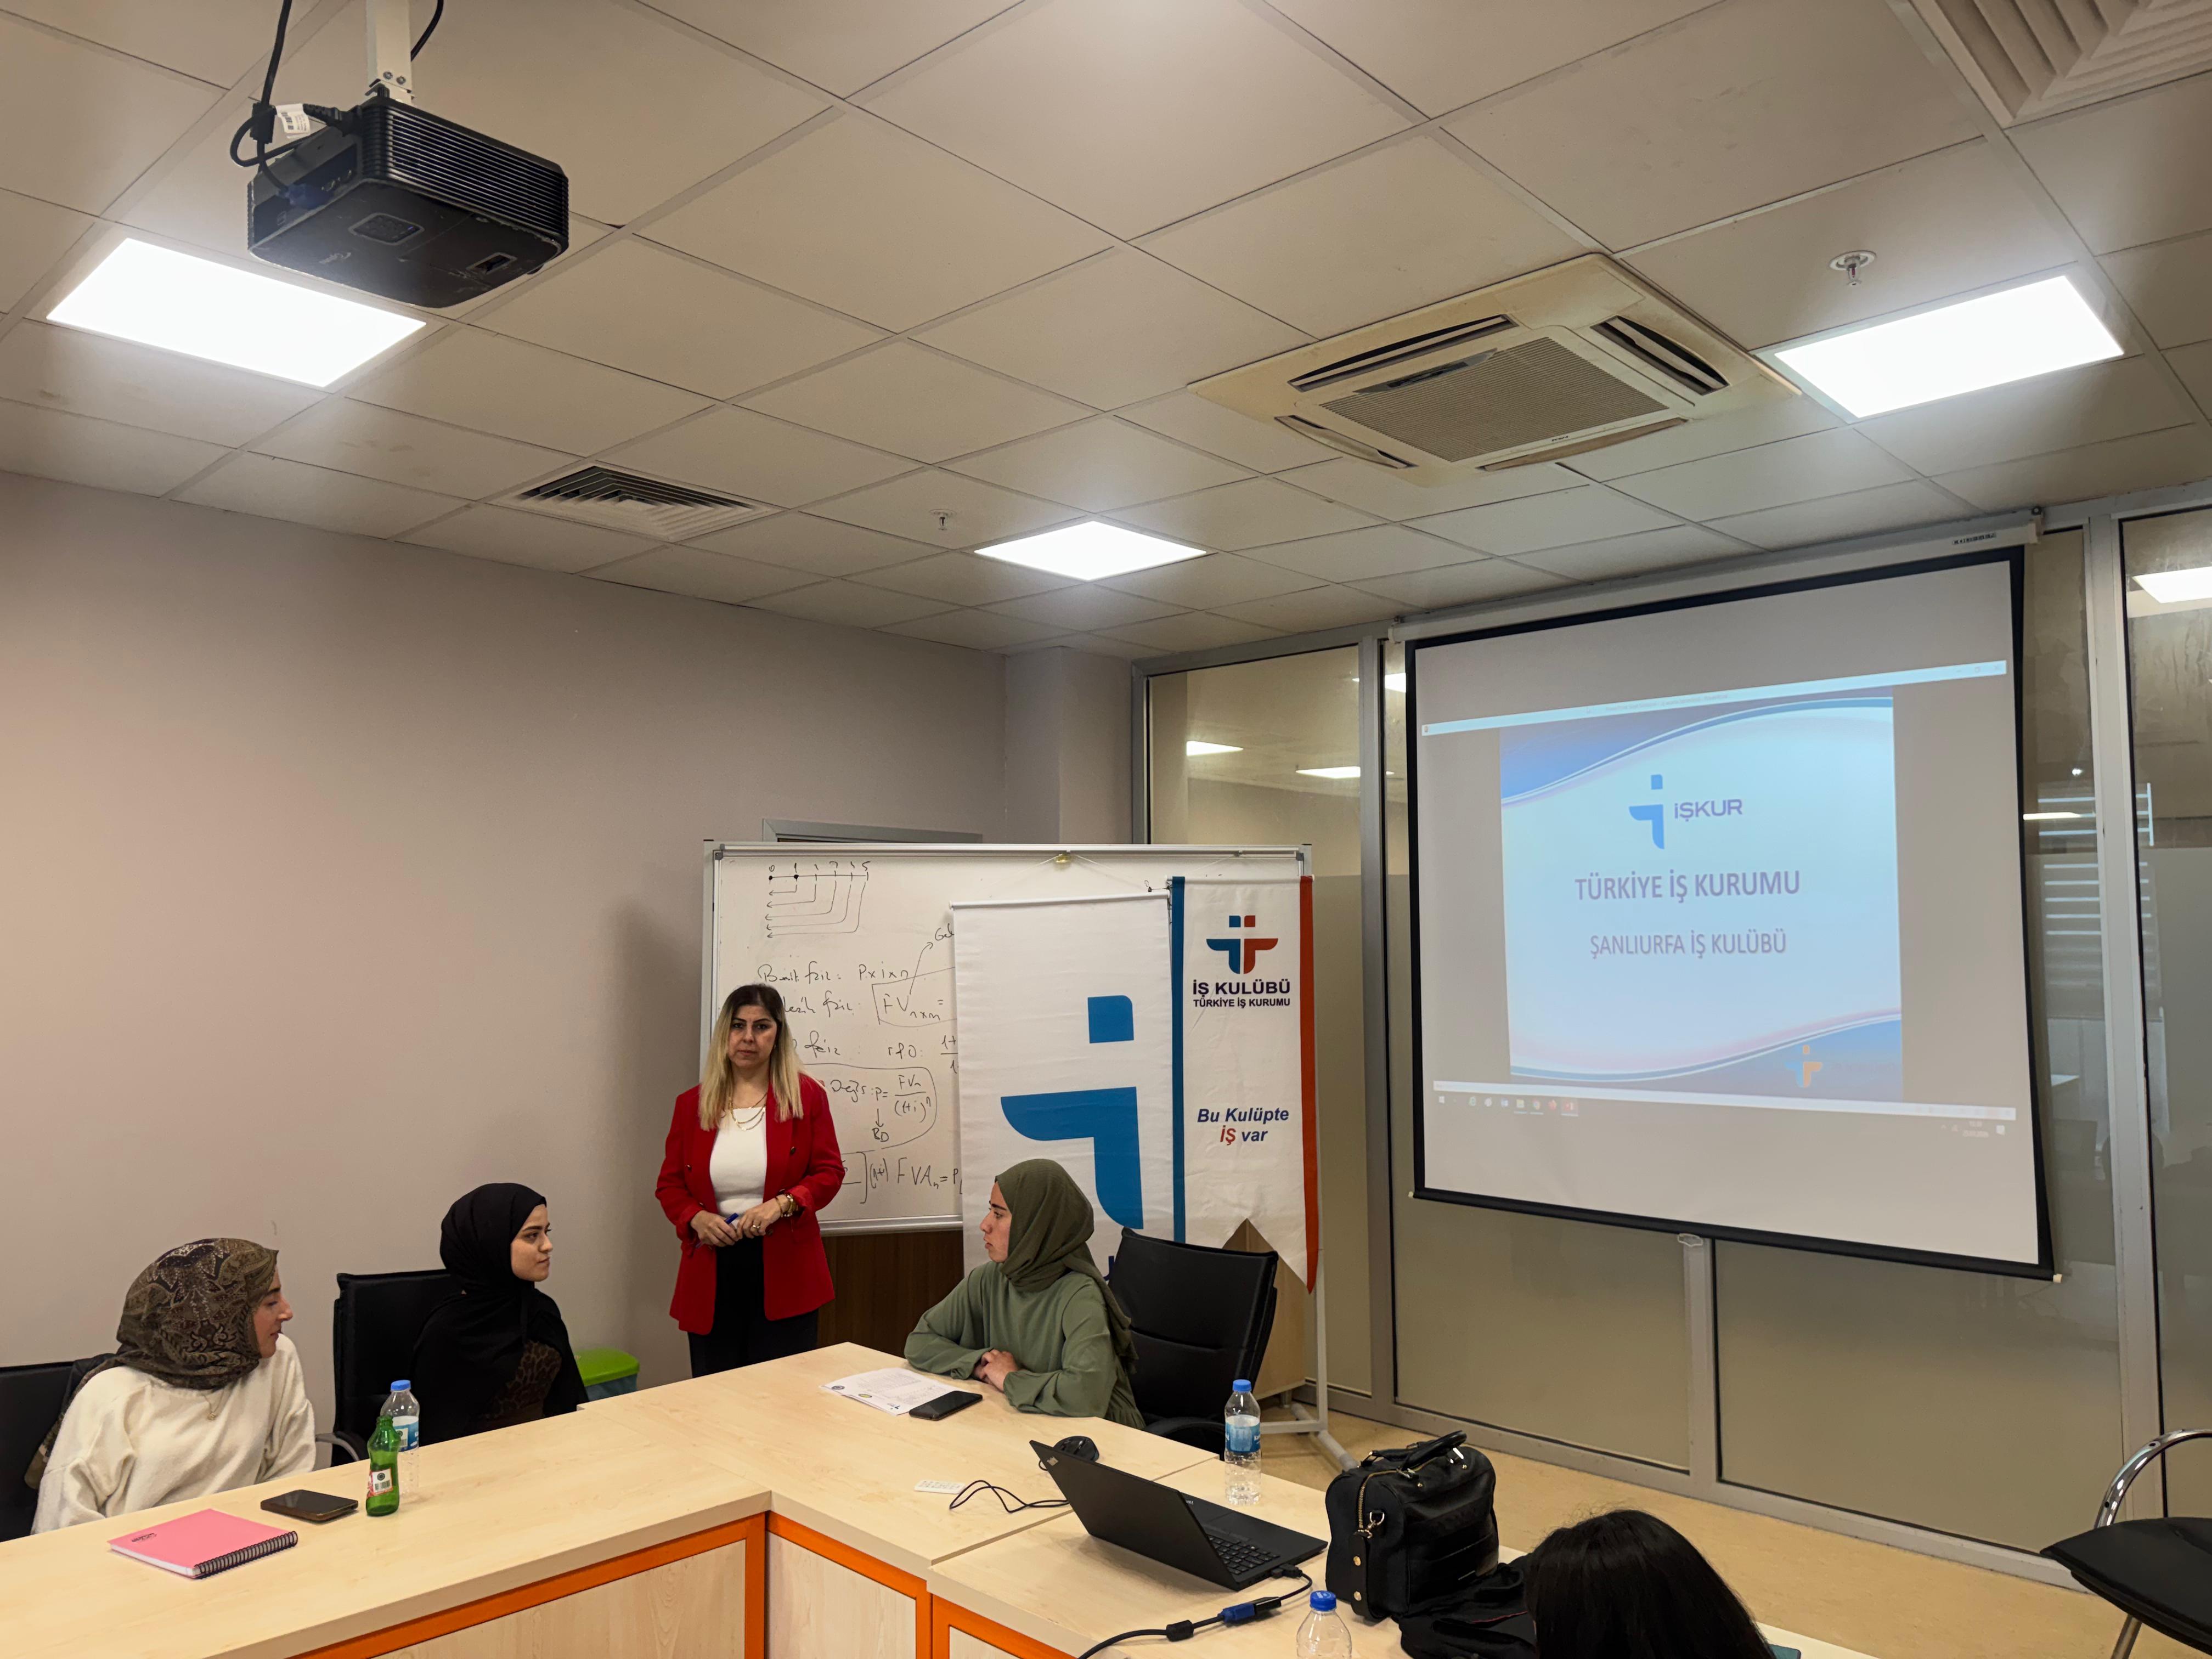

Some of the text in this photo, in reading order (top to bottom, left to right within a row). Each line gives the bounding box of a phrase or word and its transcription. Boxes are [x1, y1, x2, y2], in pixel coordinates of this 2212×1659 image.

[1575, 868, 1801, 904] TÜRKİYE İŞ KURUMU
[1590, 928, 1786, 960] ŞANLIURFA İŞ KULÜBÜ
[1193, 978, 1290, 997] İŞ KULÜBÜ
[1193, 998, 1290, 1008] TÜRKİYE İŞ KURUMU
[1197, 1107, 1289, 1125] Bu Kulüpte
[1220, 1125, 1268, 1146] İŞ var
